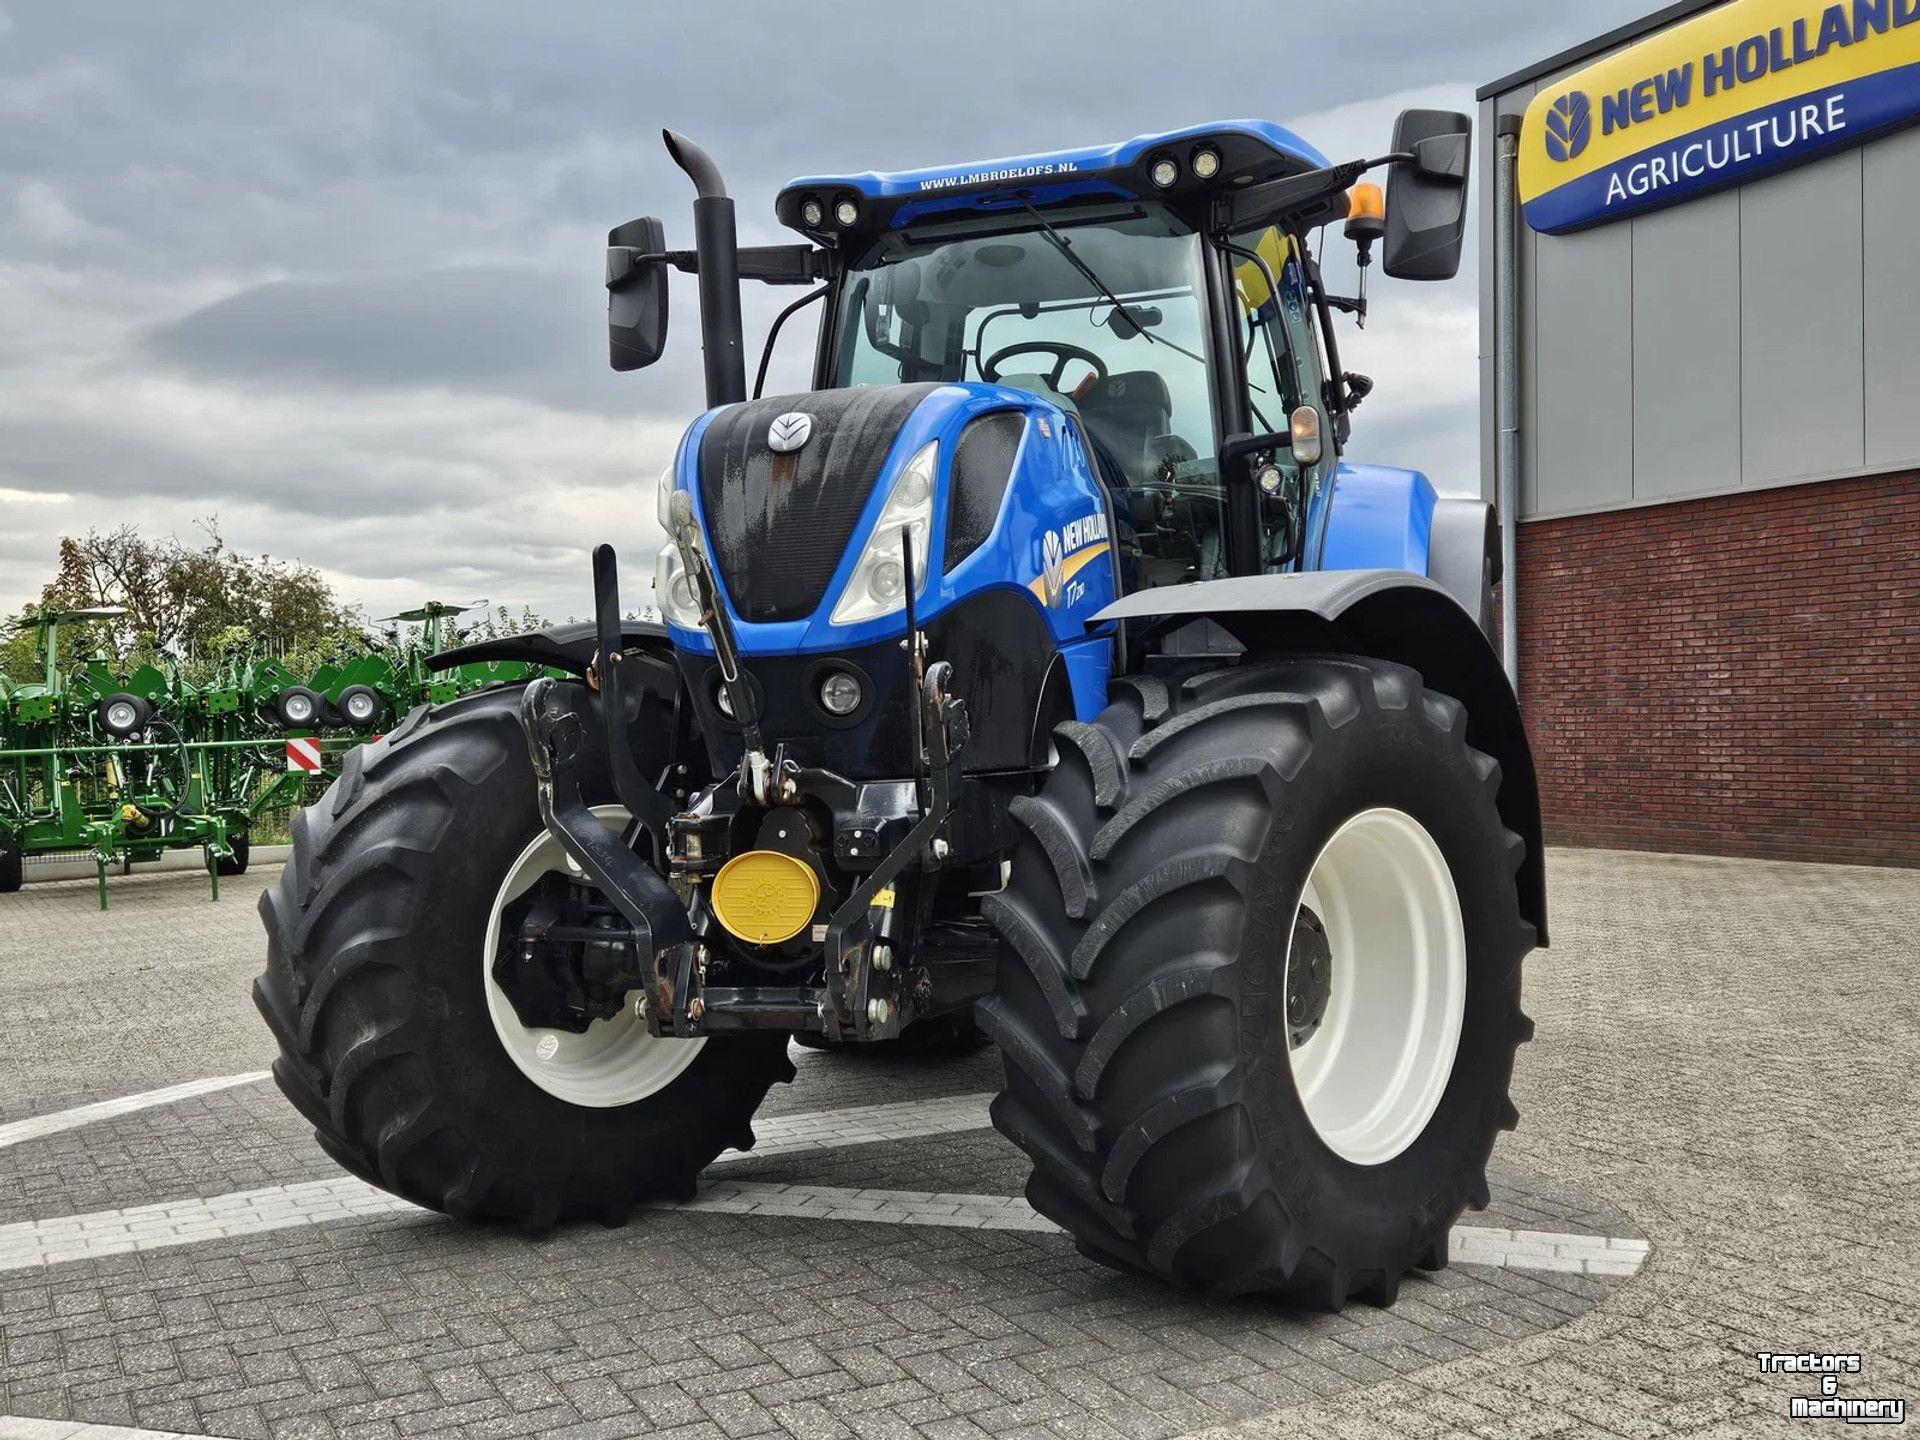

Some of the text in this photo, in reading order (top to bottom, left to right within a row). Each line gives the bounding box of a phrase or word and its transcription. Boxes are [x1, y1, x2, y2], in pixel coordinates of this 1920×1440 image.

[1602, 62, 1692, 136] NEW
[919, 162, 1078, 191] WWW.LMBROELOFS.NL
[1606, 94, 1846, 205] AGRICULTURE
[1062, 518, 1083, 554] NEW
